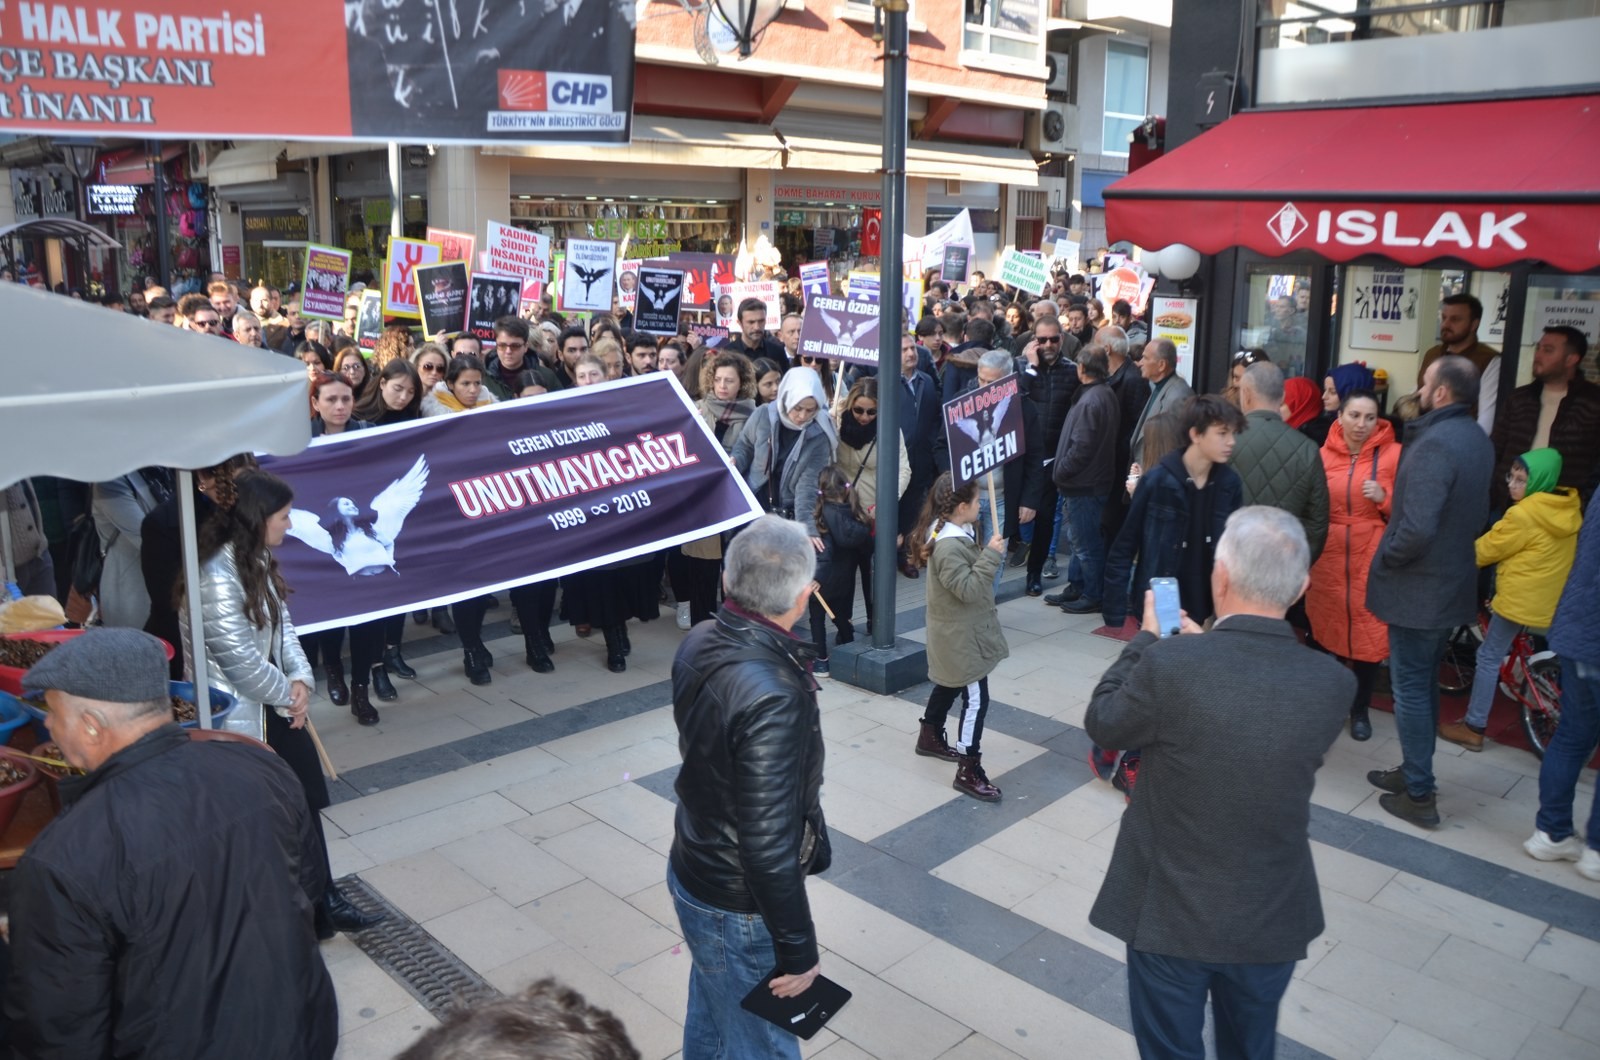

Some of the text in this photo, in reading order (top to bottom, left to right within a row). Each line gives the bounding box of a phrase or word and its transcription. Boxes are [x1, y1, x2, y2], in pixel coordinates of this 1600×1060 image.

[19, 1, 126, 47] HALK
[134, 11, 266, 56] PARTİSİ
[51, 50, 214, 89] BAŞKANI
[19, 84, 155, 124] İNANLI
[551, 80, 608, 106] CHP
[492, 113, 546, 128] TÜRKİYE'NİN
[600, 114, 622, 127] GÜCÜ
[806, 188, 846, 200] BAHARAT
[500, 226, 538, 245] KADINA
[594, 211, 668, 240] CENGİZ
[1316, 209, 1528, 250] ISLAK
[490, 245, 546, 269] İNSANLIĞA
[491, 257, 544, 280] İHANETTİR
[1012, 252, 1045, 270] KADINLAR
[813, 296, 846, 312] CEREN
[1372, 285, 1404, 320] YOK
[803, 340, 879, 361] SENİ UNUTMAYACAĞ
[975, 379, 1018, 412] DOĞDUN
[508, 421, 611, 456] CEREN ÖZDEMİR
[960, 430, 1018, 481] CEREN
[448, 431, 700, 520] UNUTMAYACAĞIZ
[547, 489, 652, 531] 1999 2019
